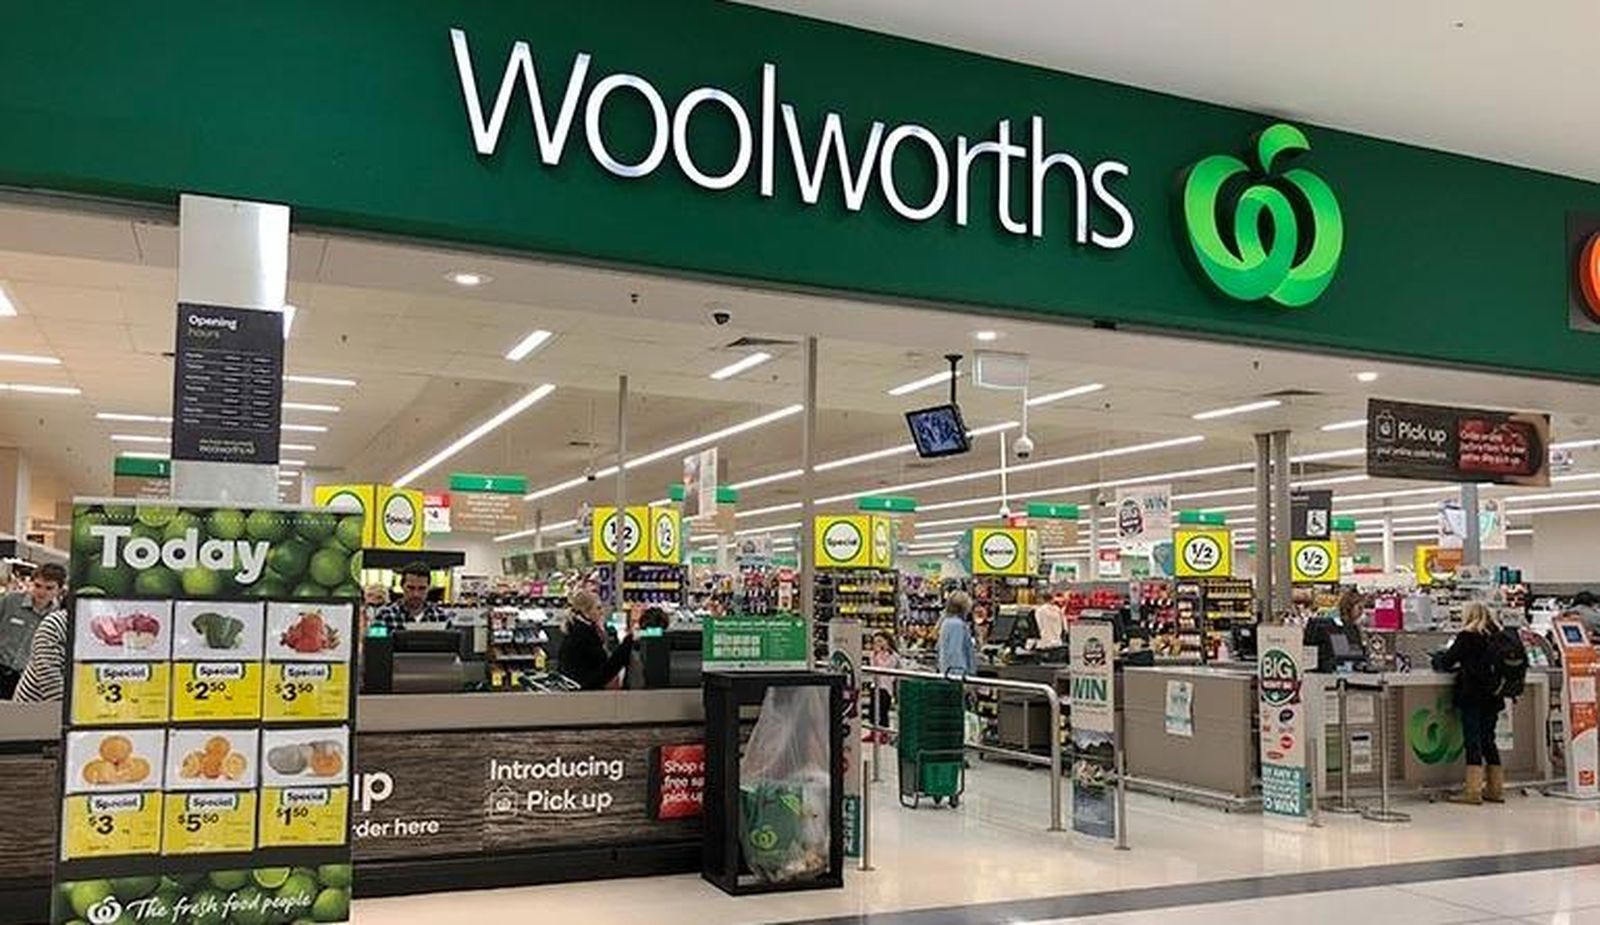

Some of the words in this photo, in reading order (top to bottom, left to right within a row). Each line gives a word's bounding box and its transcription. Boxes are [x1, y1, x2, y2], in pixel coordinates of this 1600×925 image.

[450, 28, 1136, 250] Woolworths
[188, 314, 238, 331] Opening
[1397, 421, 1427, 441] Pick
[1429, 428, 1447, 446] up
[484, 479, 494, 489] 2
[385, 513, 412, 524] Special
[827, 537, 857, 546] Special
[90, 524, 270, 585] Today
[984, 546, 1014, 556] Special
[103, 667, 145, 680] Special
[200, 666, 239, 676] Special
[288, 665, 325, 677] Special
[1263, 656, 1293, 678] BIG
[96, 683, 122, 703] $3
[490, 755, 624, 781] Introducing
[664, 760, 697, 774] Shop
[664, 775, 689, 787] free
[193, 798, 233, 808] Special
[287, 791, 325, 801] Special
[527, 789, 578, 811] Pick
[582, 793, 613, 813] up
[663, 790, 690, 804] pick
[95, 798, 138, 809] Special
[88, 815, 114, 835] $3
[394, 818, 439, 837] here
[126, 897, 168, 920] The
[170, 895, 218, 923] fresh
[221, 892, 262, 919] food
[260, 890, 311, 914] people
